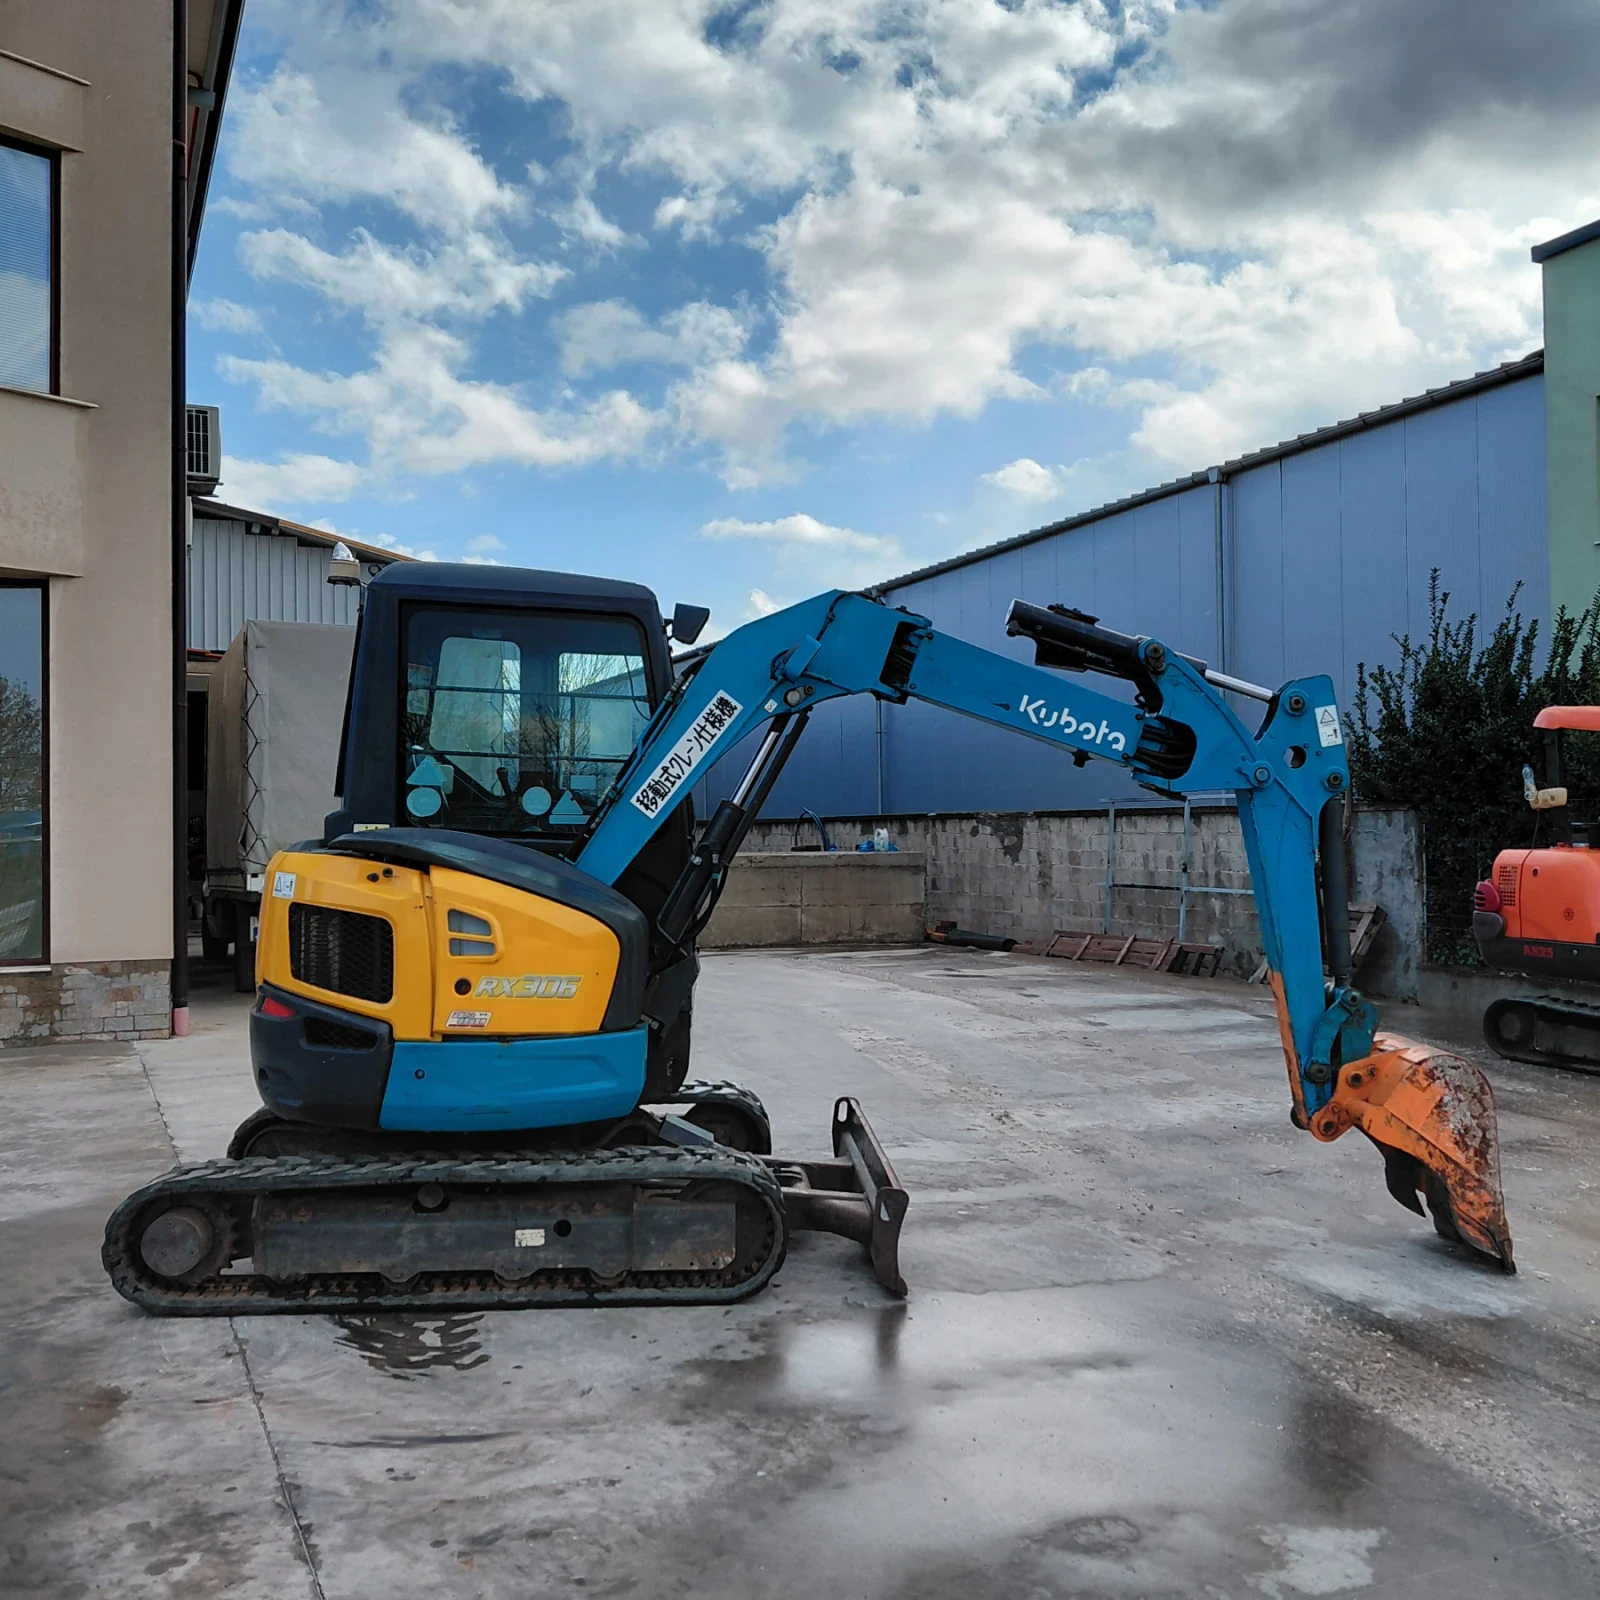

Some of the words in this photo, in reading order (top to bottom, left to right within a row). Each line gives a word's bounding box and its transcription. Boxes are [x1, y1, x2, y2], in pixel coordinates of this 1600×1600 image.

[1019, 694, 1126, 752] Kubota
[635, 696, 738, 814] 移動式クレーン仕様機
[474, 974, 583, 999] RX306
